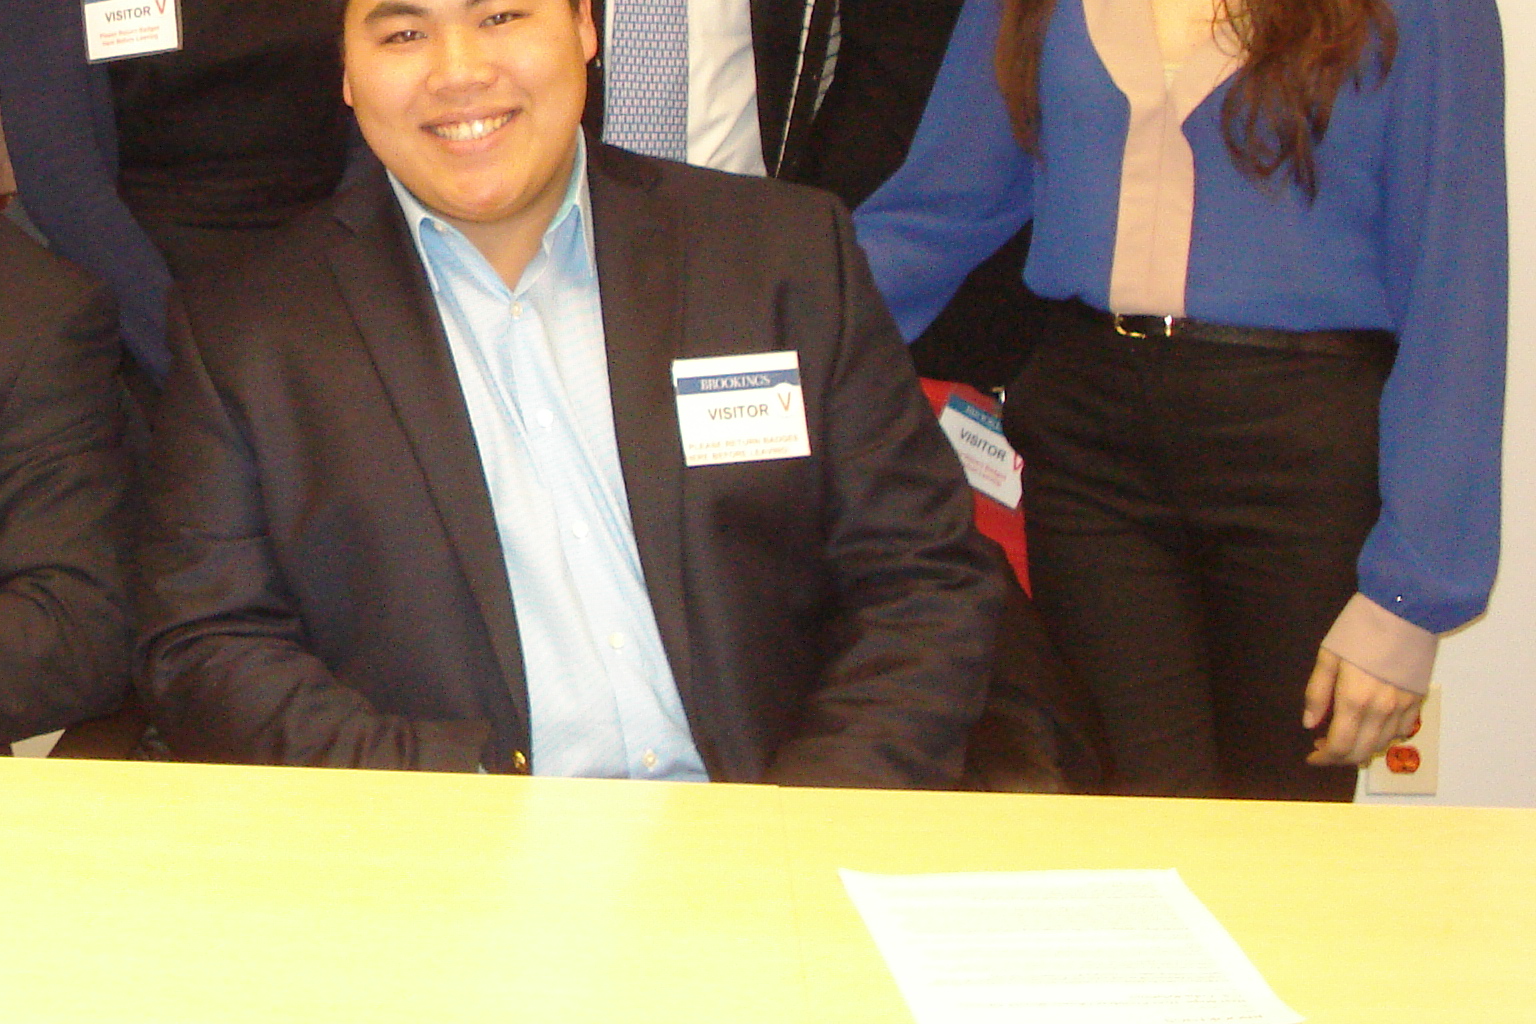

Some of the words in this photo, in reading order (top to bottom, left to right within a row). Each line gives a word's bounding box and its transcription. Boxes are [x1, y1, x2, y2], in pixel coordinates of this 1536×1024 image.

[105, 6, 151, 23] VISITOR
[700, 375, 772, 391] BROOKINGS
[708, 404, 769, 421] VISITOR
[777, 391, 792, 412] V
[960, 428, 1007, 462] VISITOR
